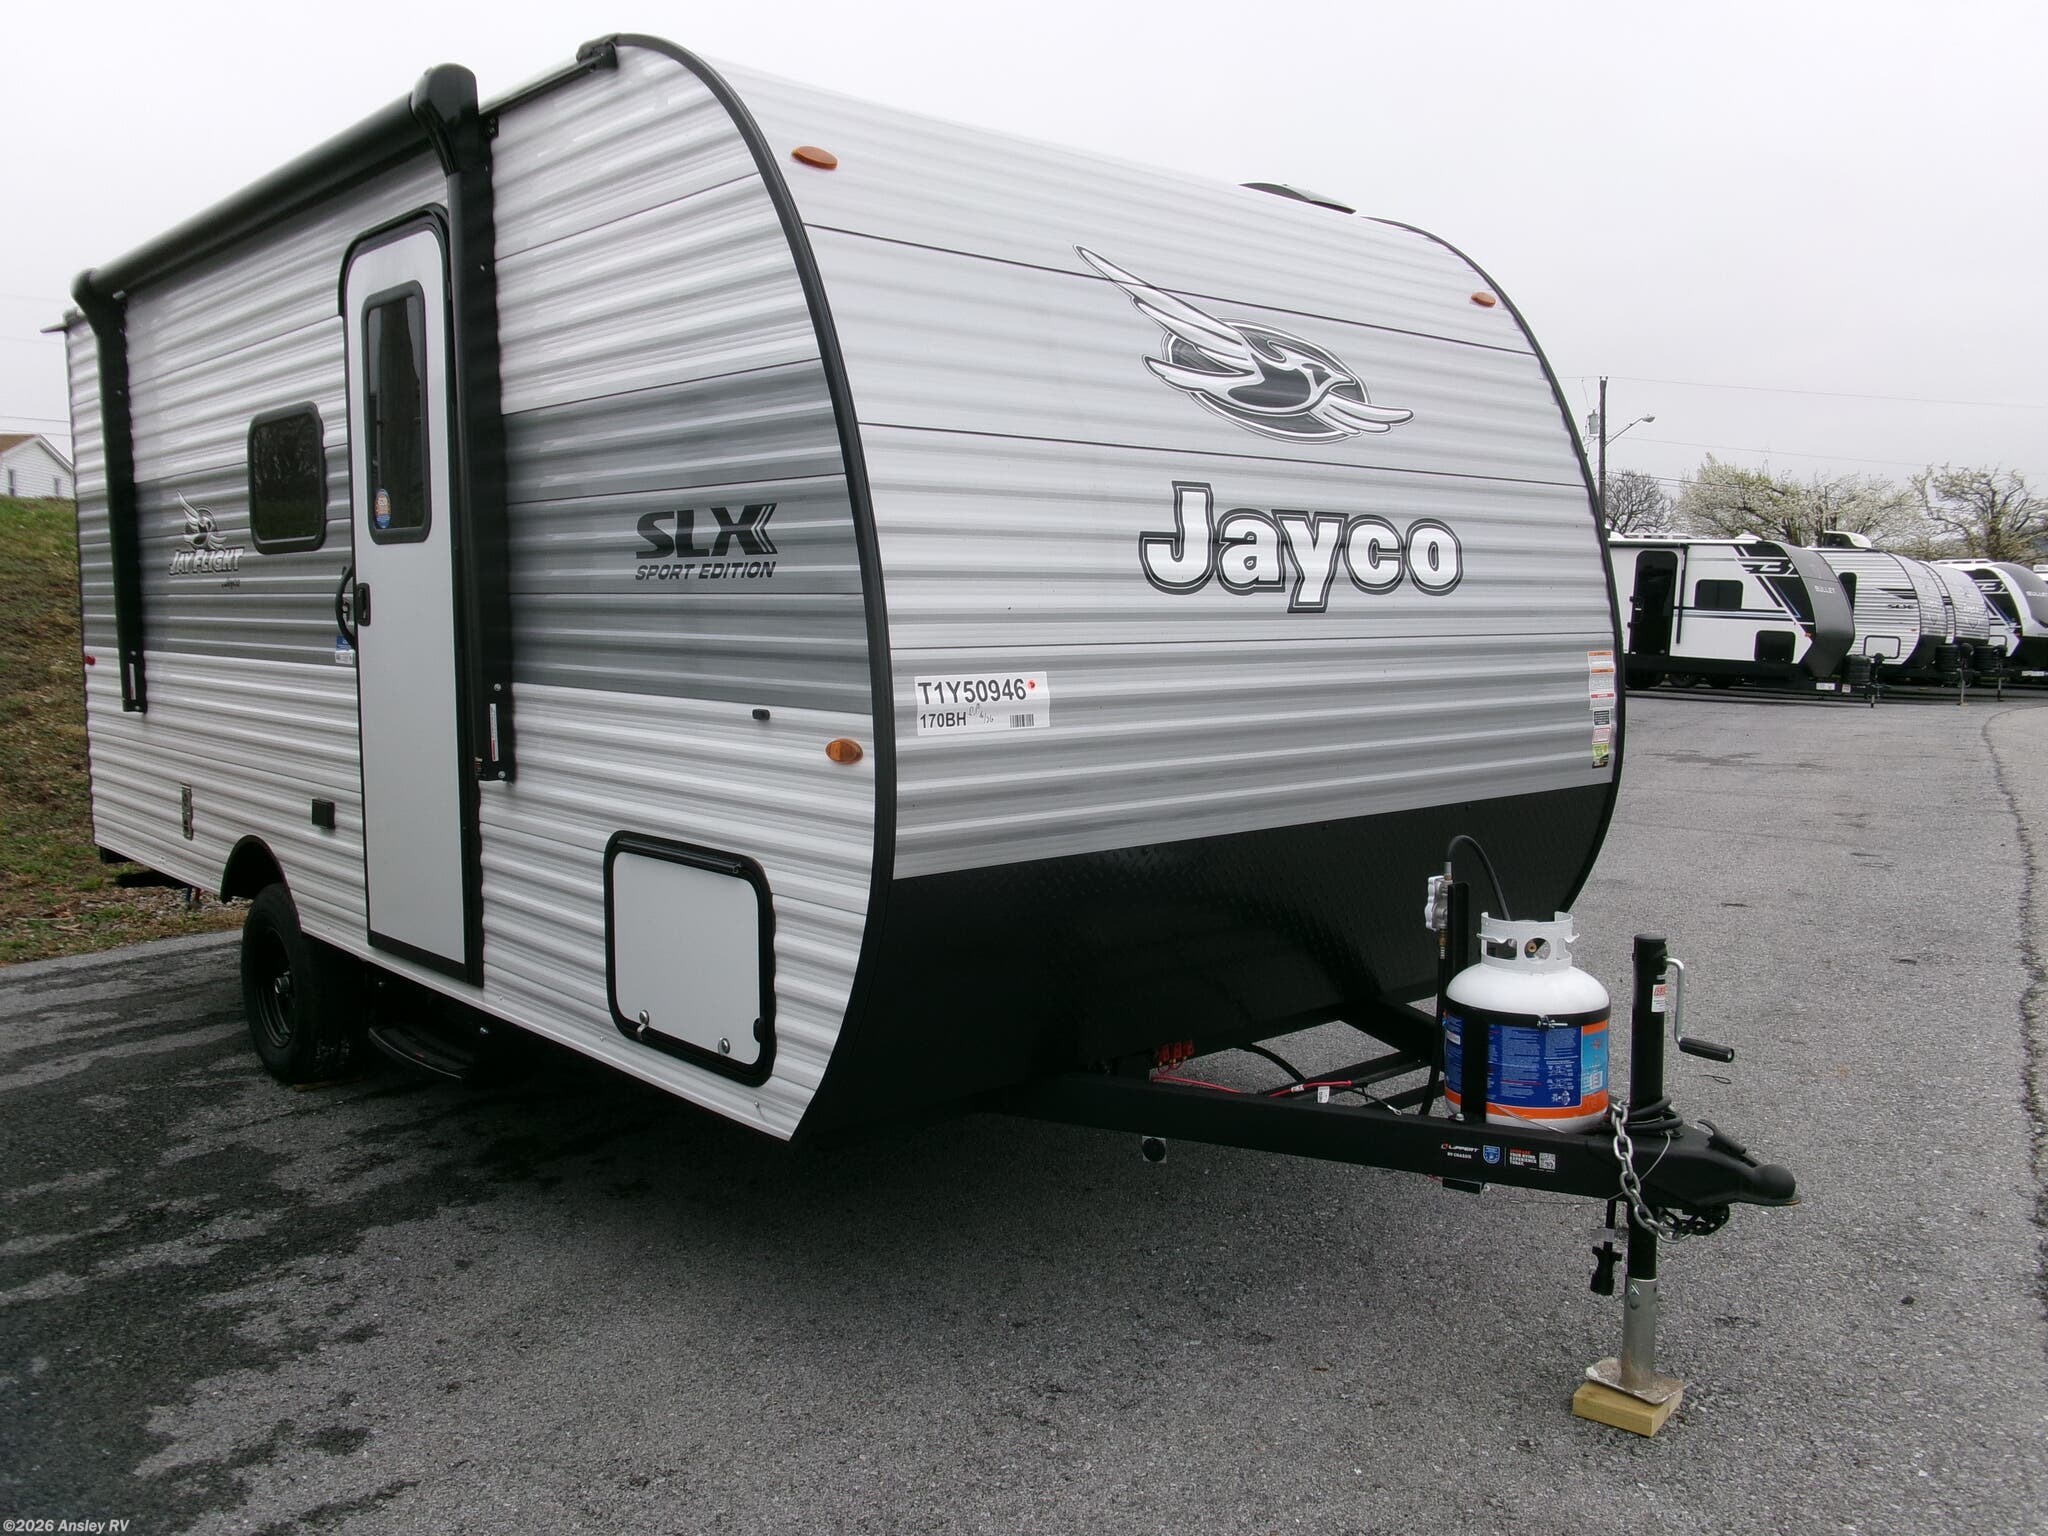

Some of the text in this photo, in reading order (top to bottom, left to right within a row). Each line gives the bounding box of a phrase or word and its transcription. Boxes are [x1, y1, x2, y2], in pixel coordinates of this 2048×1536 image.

[636, 503, 778, 559] SLX
[1139, 480, 1463, 613] Jayco
[168, 547, 245, 576] JAY FLIGHT
[635, 561, 776, 580] SPORT EDITION
[918, 678, 1027, 704] T1Y50946
[920, 711, 967, 729] 170BH
